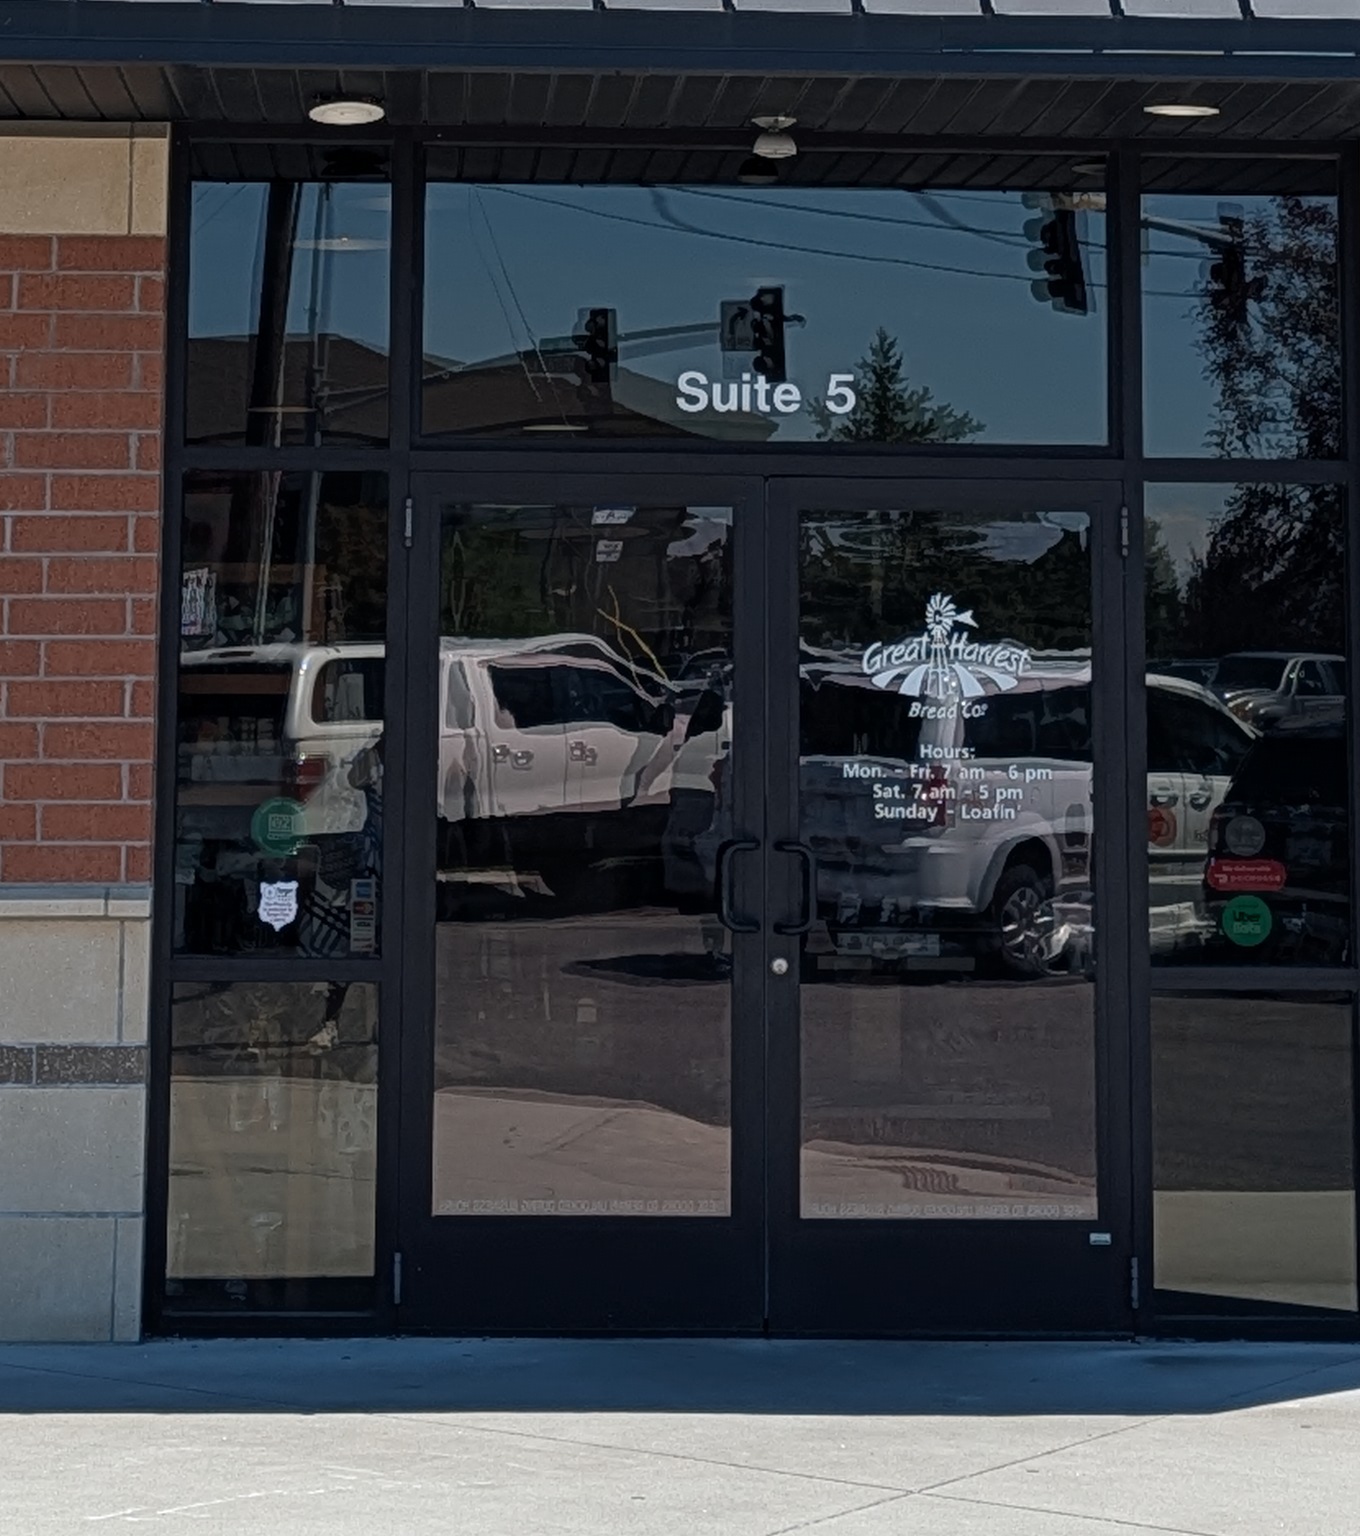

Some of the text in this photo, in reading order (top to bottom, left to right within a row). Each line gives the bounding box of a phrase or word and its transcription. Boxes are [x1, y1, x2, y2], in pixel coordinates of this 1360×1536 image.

[676, 371, 856, 414] Suite 5
[862, 632, 1032, 675] Great Harvest
[908, 702, 956, 719] Bread
[920, 744, 976, 760] Hours:
[843, 765, 887, 779] Mon.
[910, 765, 935, 779] Fri.
[942, 765, 951, 779] 7
[959, 768, 985, 779] am
[1008, 765, 1018, 779] 6
[1025, 768, 1053, 784] pm
[873, 785, 905, 799] Sat.
[912, 785, 922, 799] 7
[929, 788, 956, 799] am
[979, 785, 989, 799] 5
[996, 788, 1023, 803] pm
[874, 804, 938, 822] Sunday
[1233, 910, 1261, 922] Uber
